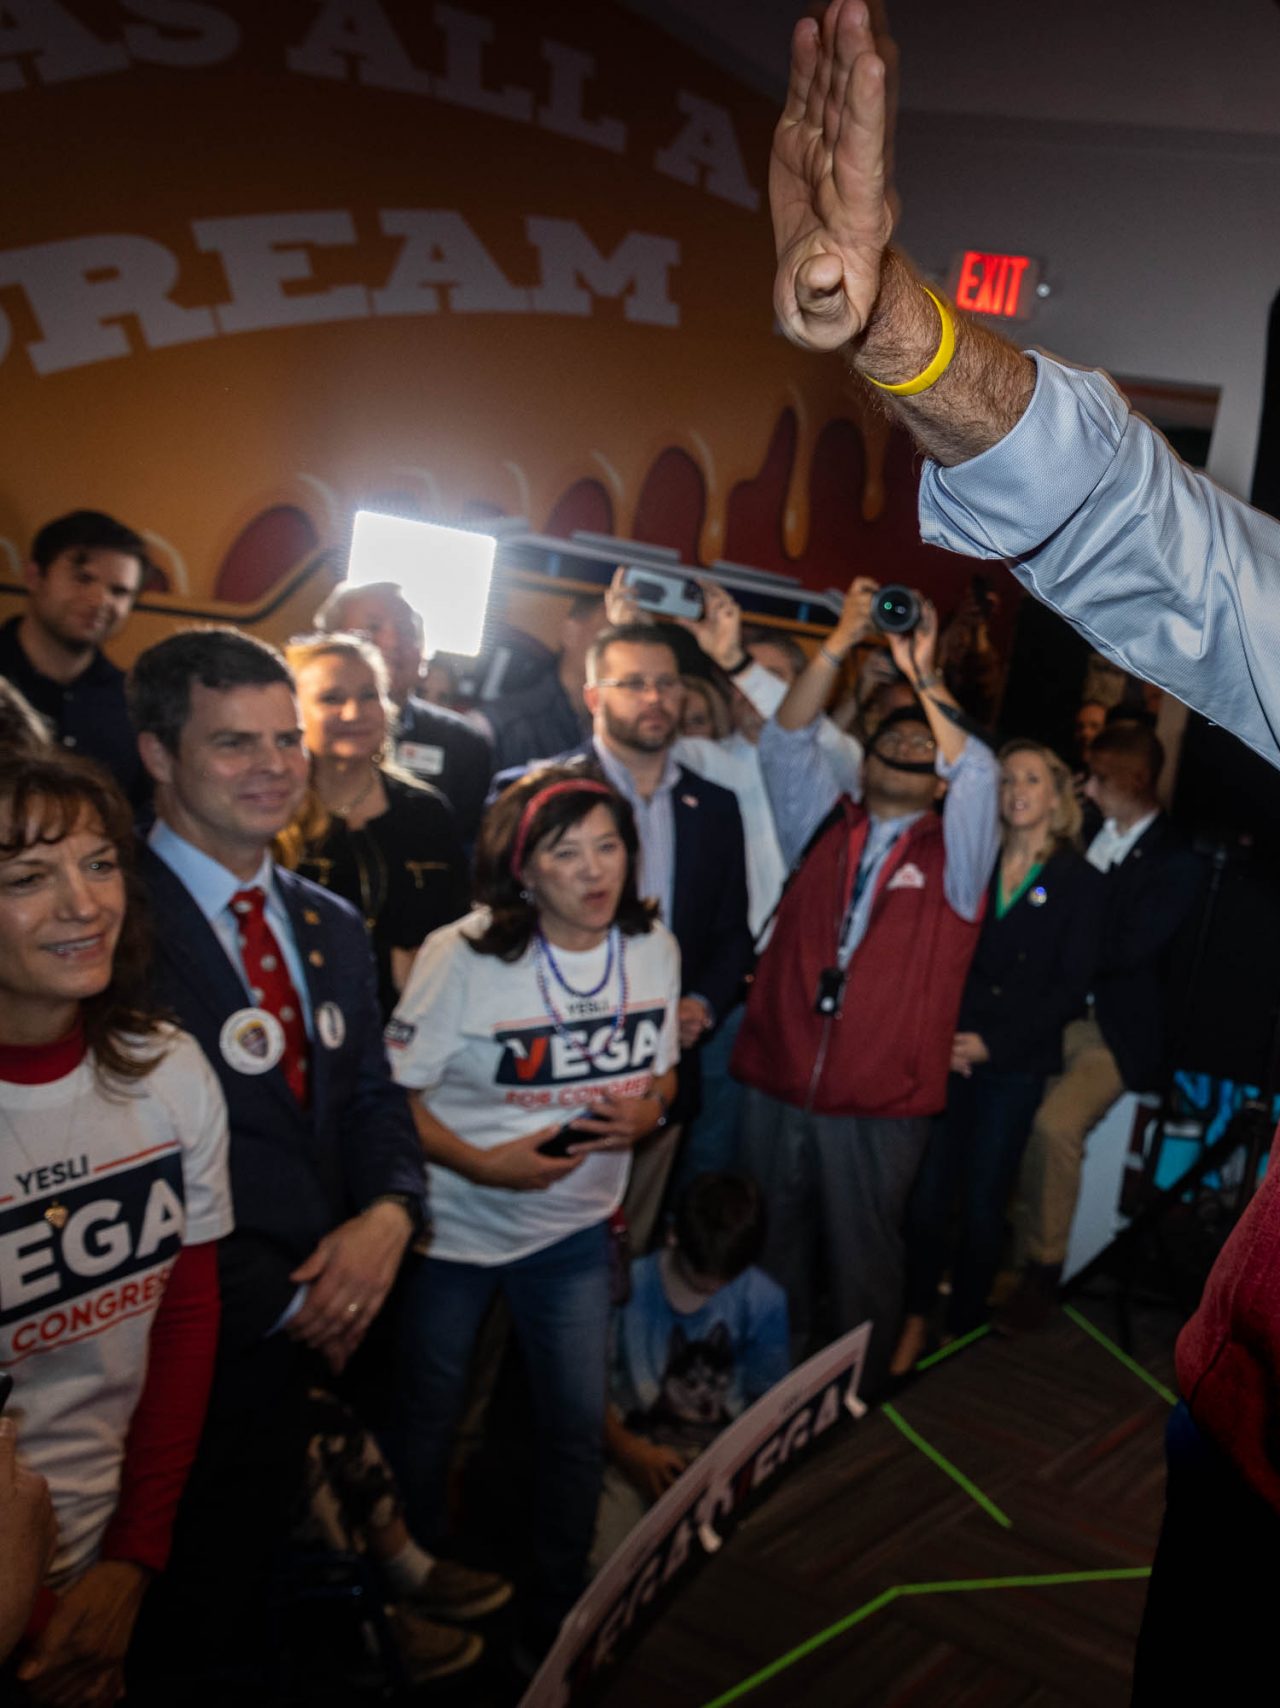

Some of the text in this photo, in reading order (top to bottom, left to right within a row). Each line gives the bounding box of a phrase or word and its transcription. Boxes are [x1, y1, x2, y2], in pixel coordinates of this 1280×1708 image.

[284, 0, 626, 154] ALL
[654, 88, 762, 213] A
[0, 207, 682, 378] REAM
[956, 250, 1030, 318] EXIT
[505, 1018, 662, 1082] VEGA
[16, 1154, 90, 1195] YESLI
